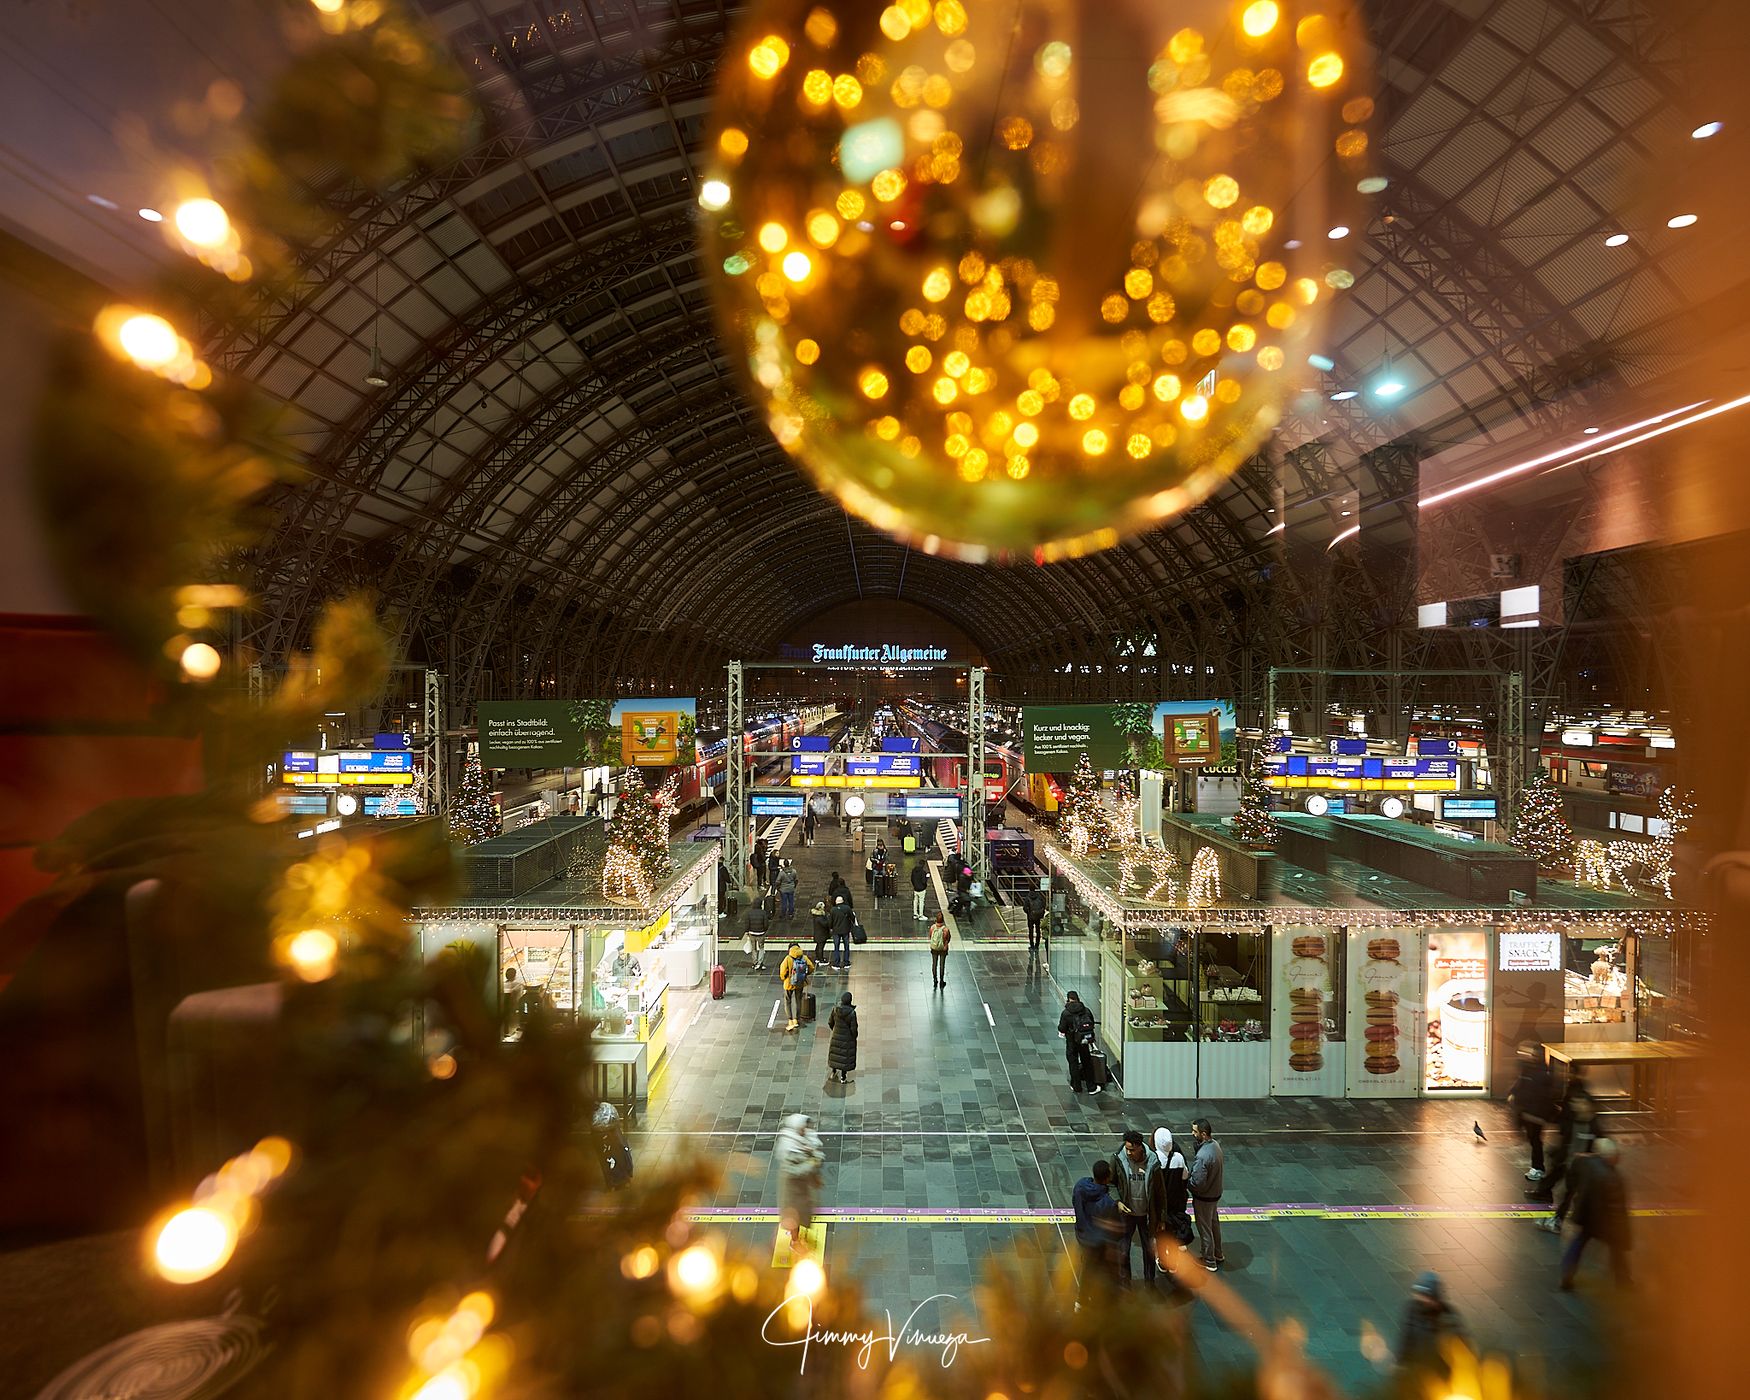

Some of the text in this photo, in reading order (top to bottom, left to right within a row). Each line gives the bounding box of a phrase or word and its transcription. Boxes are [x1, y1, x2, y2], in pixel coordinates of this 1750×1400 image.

[812, 643, 880, 663] Frankfurter
[880, 643, 948, 663] Allgemeine
[488, 718, 548, 727] Passt ins Stadtbild:
[1033, 722, 1090, 733] Kurz und knackig:
[488, 727, 555, 738] einfach überragend.
[1033, 732, 1091, 742] lecker und vegan.
[403, 734, 411, 746] 5
[792, 736, 801, 749] 6
[911, 737, 919, 749] 7
[1329, 740, 1338, 751] 8
[1448, 740, 1457, 752] 9
[1508, 949, 1539, 958] SNACK
